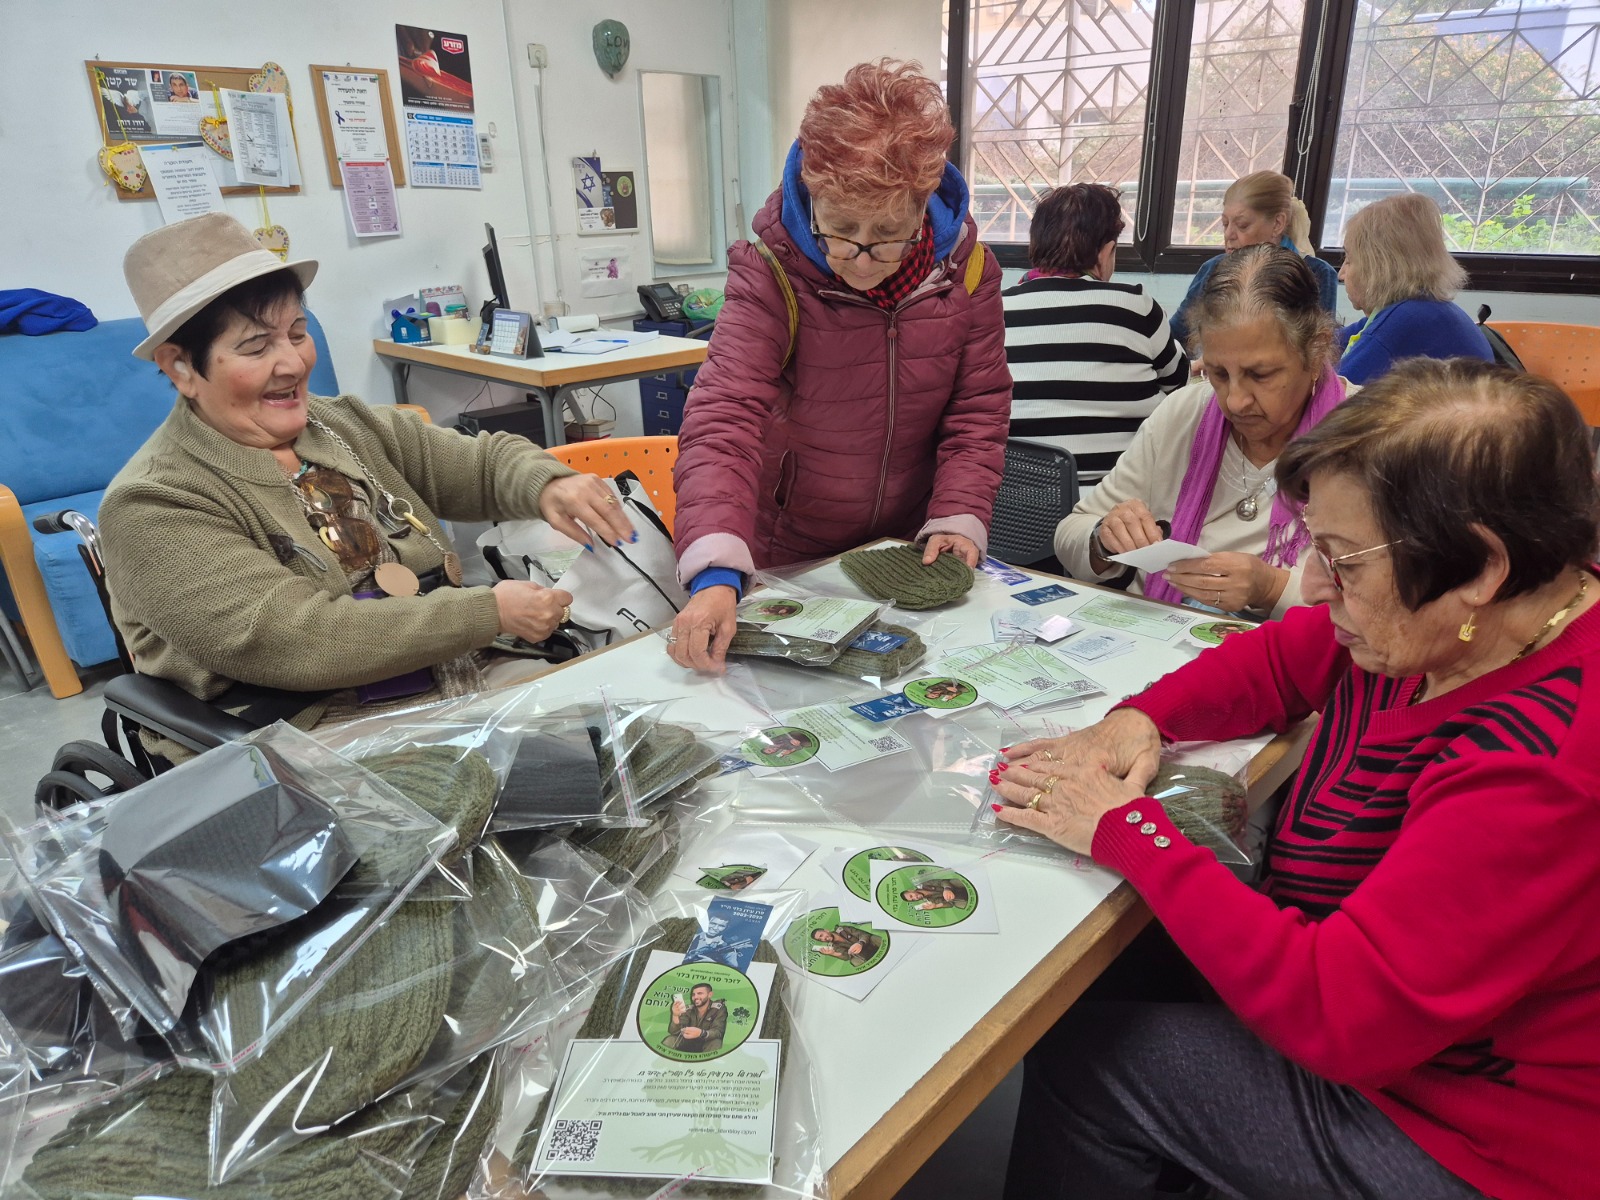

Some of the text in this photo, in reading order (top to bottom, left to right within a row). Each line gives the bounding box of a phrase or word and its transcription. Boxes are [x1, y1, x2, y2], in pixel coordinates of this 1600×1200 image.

[106, 76, 138, 88] שר קטן
[653, 990, 670, 998] הוא
[645, 998, 671, 1007] לוחם
[707, 1070, 721, 1079] עידן
